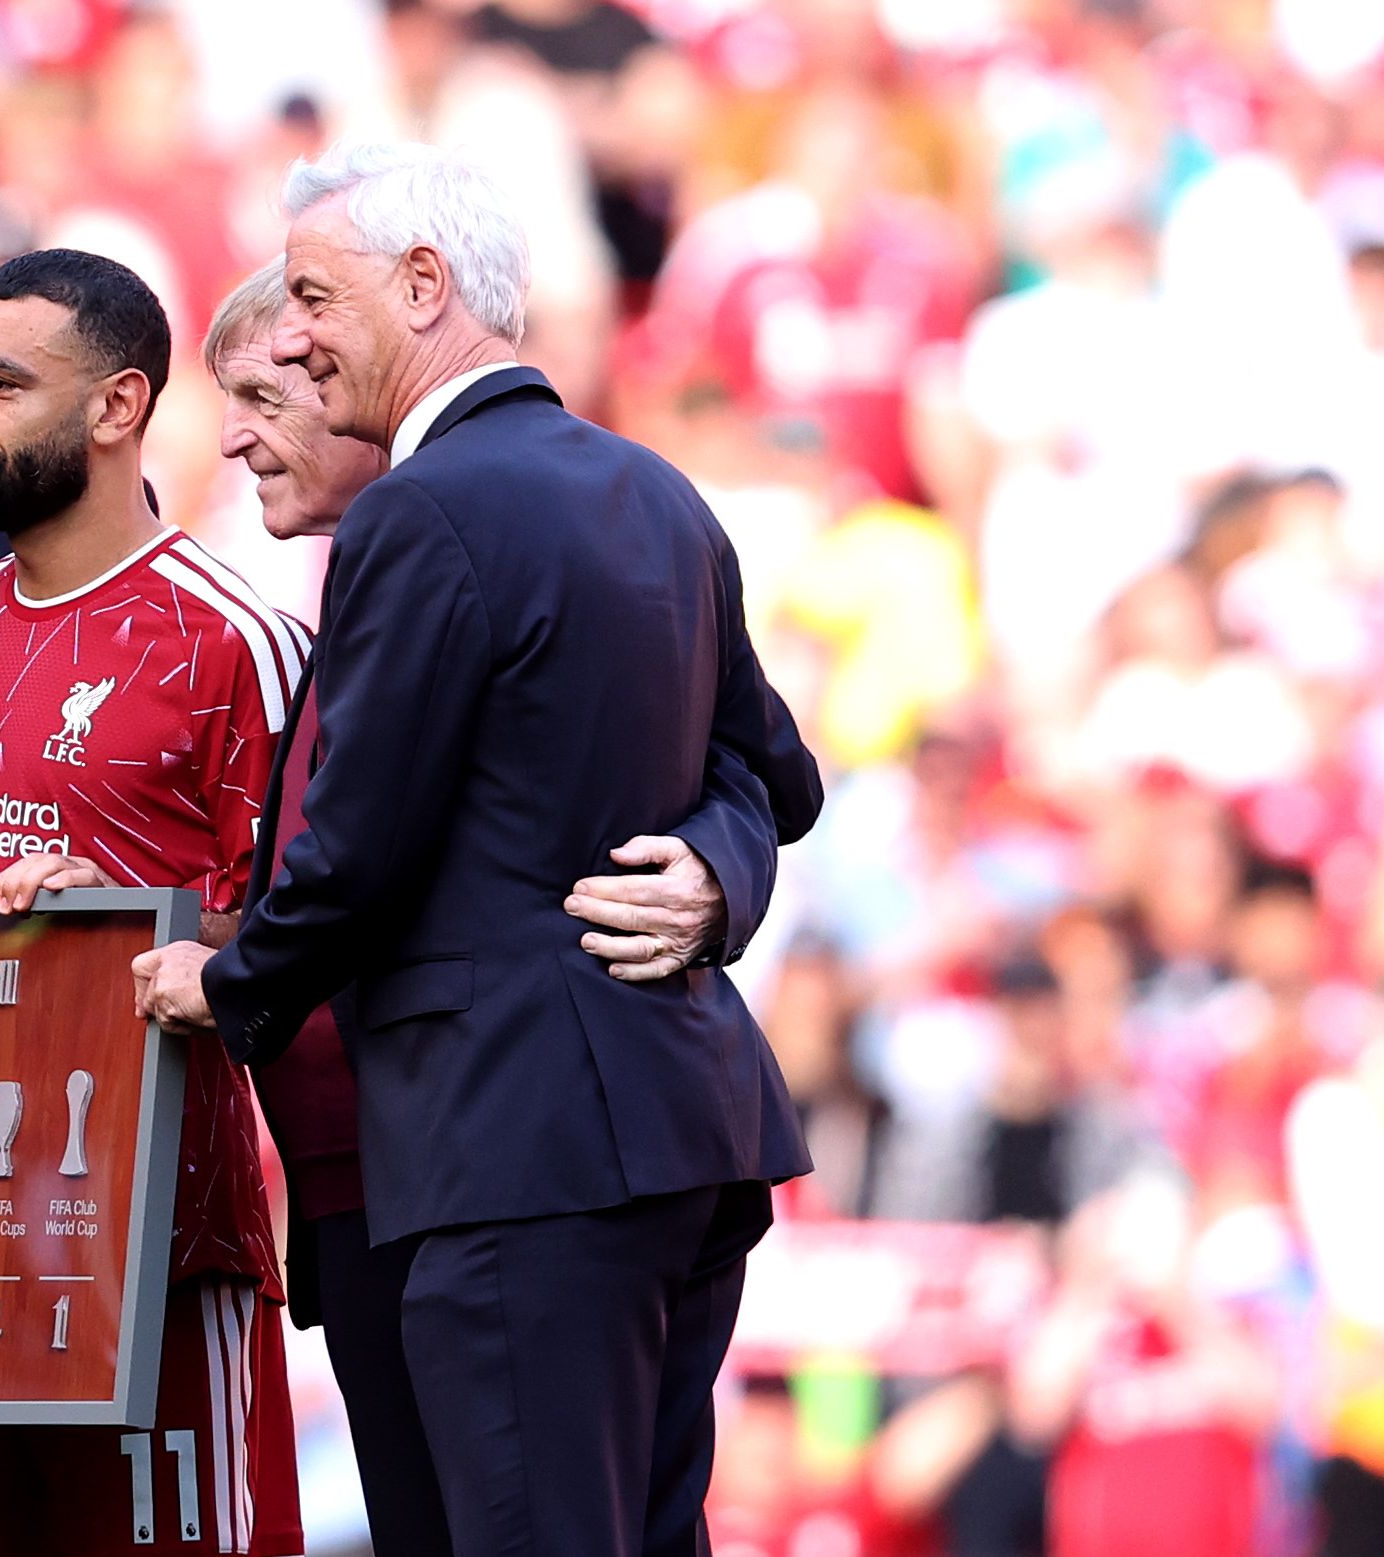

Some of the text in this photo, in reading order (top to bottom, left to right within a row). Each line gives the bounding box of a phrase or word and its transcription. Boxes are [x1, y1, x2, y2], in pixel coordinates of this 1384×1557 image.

[49, 1200, 97, 1215] FIFA Club
[0, 1220, 26, 1239] Cups
[45, 1220, 98, 1238] World Cup
[52, 1295, 70, 1349] 1
[120, 1429, 201, 1544] 11
